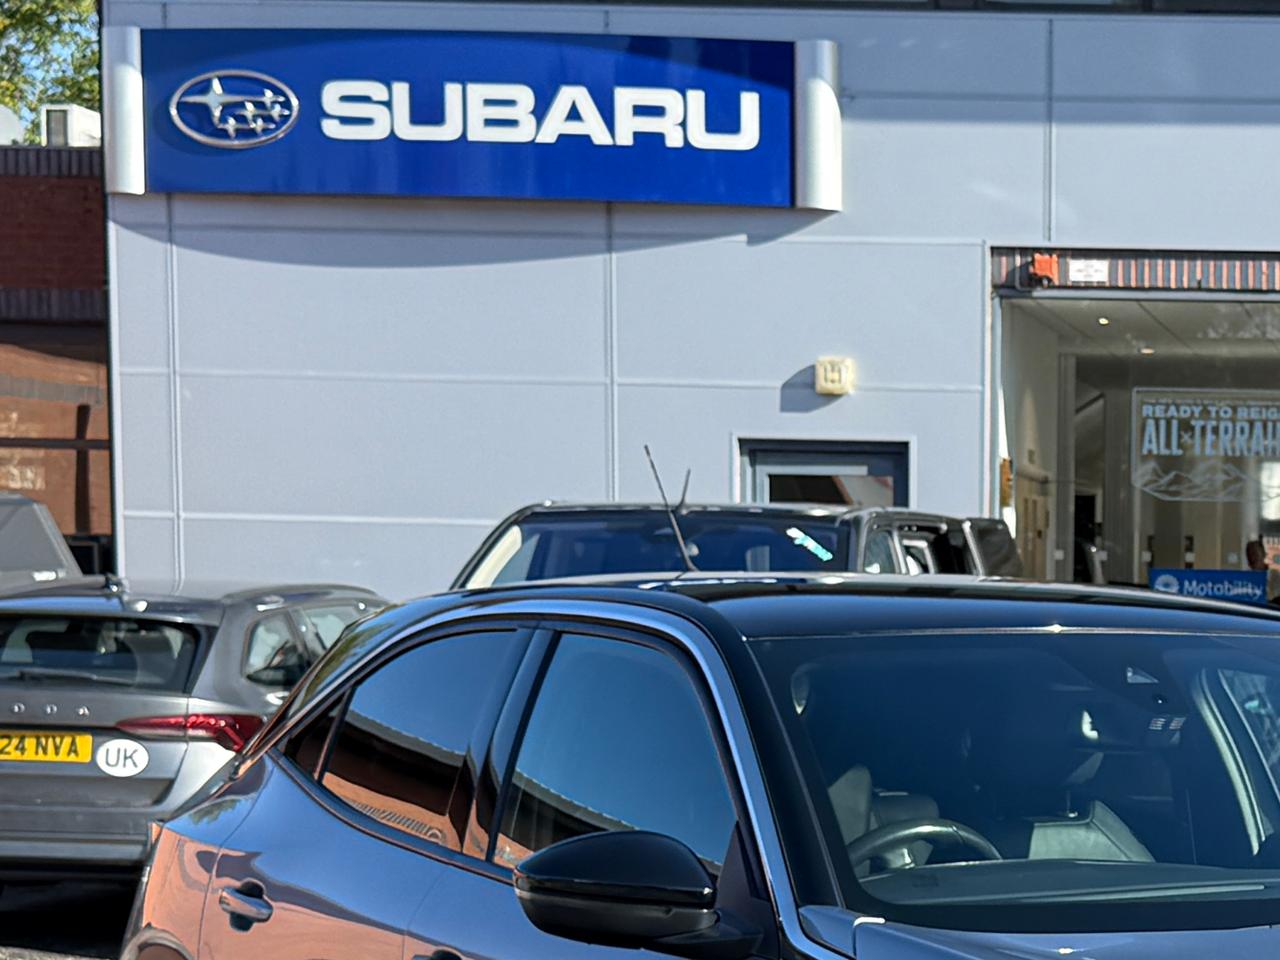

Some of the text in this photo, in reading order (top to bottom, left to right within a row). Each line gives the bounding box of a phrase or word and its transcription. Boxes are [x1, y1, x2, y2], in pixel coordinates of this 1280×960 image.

[321, 80, 760, 151] SUBARU
[1142, 404, 1203, 418] READY
[1208, 405, 1233, 418] TO
[35, 736, 80, 757] NVA
[105, 748, 138, 768] UK
